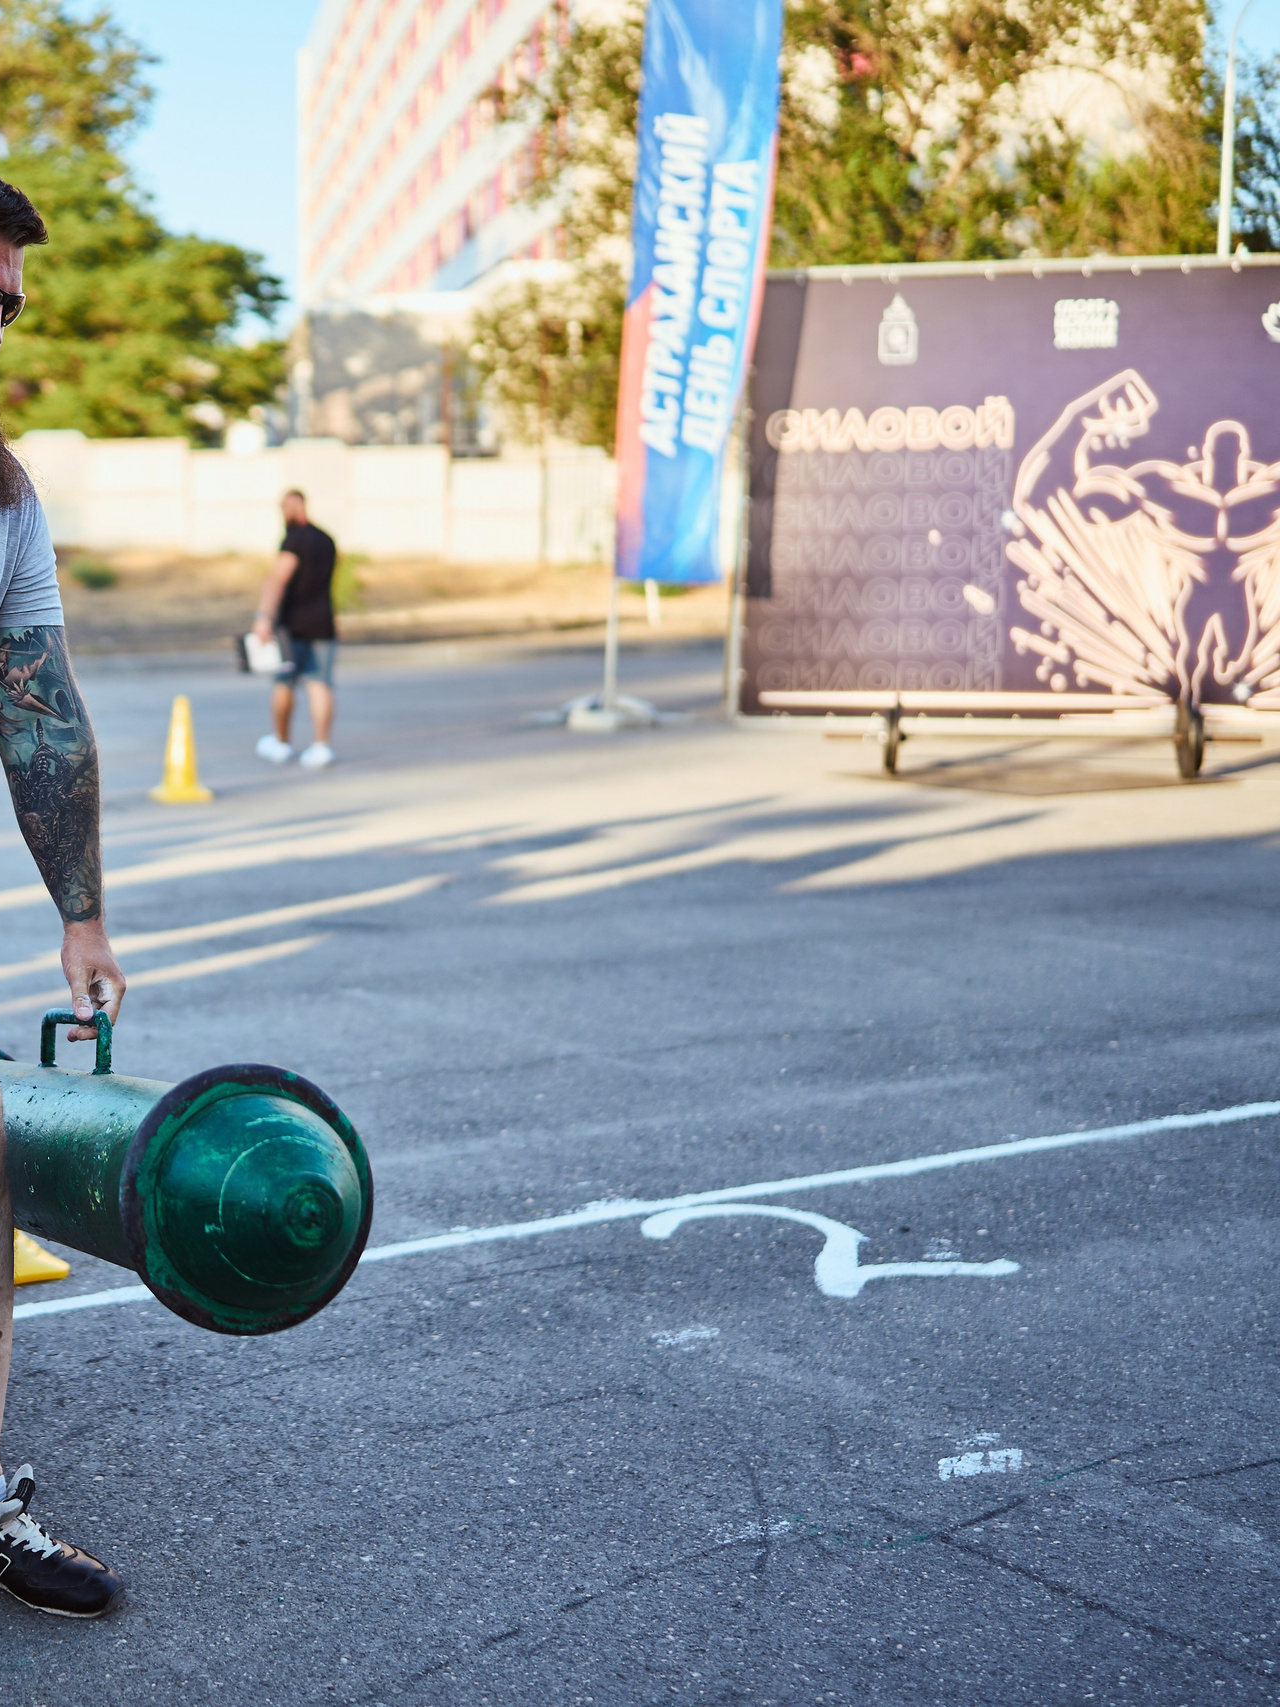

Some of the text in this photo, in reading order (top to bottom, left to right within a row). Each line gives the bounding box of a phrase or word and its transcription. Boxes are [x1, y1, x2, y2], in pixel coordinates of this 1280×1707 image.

[638, 112, 710, 459] АСТРАХАНСКИЙ
[681, 159, 760, 454] ДЕНЬ СПОРТА
[765, 395, 1015, 452] СИЛОВОЙ
